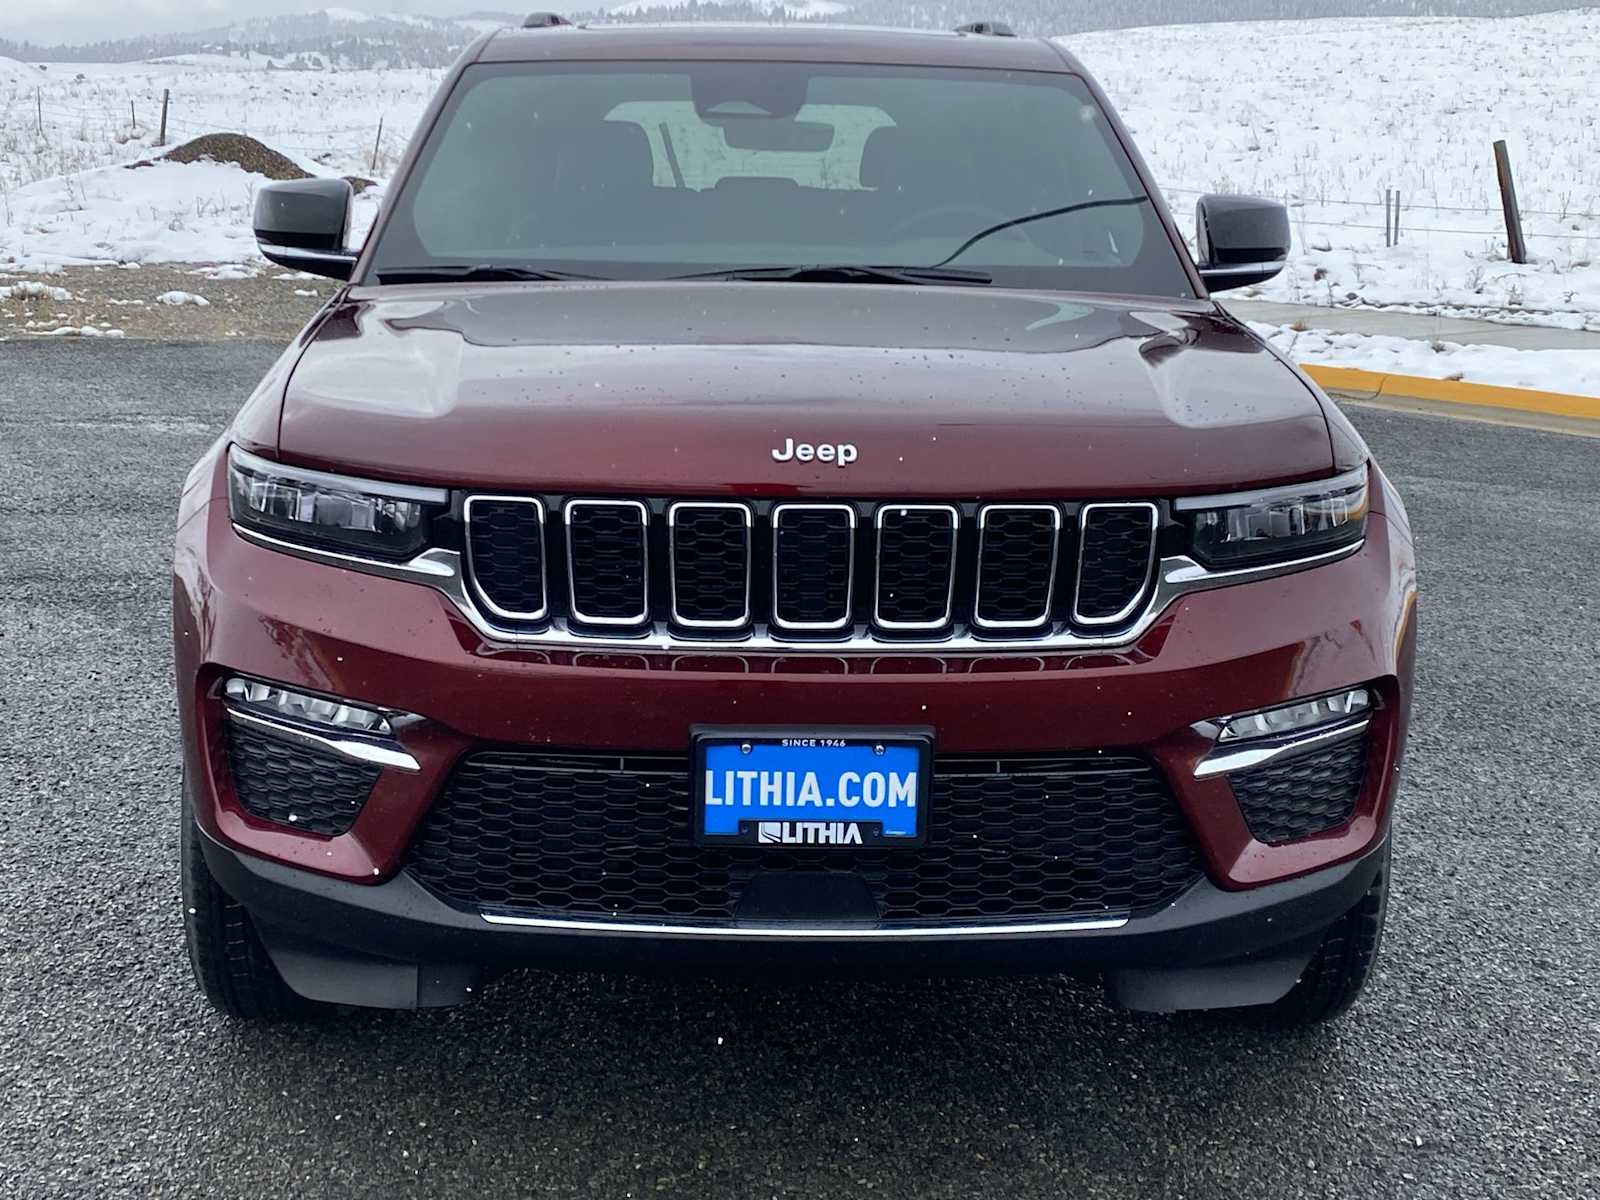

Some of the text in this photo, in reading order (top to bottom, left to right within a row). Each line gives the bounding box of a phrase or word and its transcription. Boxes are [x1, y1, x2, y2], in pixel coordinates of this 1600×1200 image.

[771, 438, 858, 466] Jeep
[782, 739, 846, 747] SINCE 1946
[705, 770, 917, 807] LITHIA.COM
[782, 822, 863, 844] LITHIA
